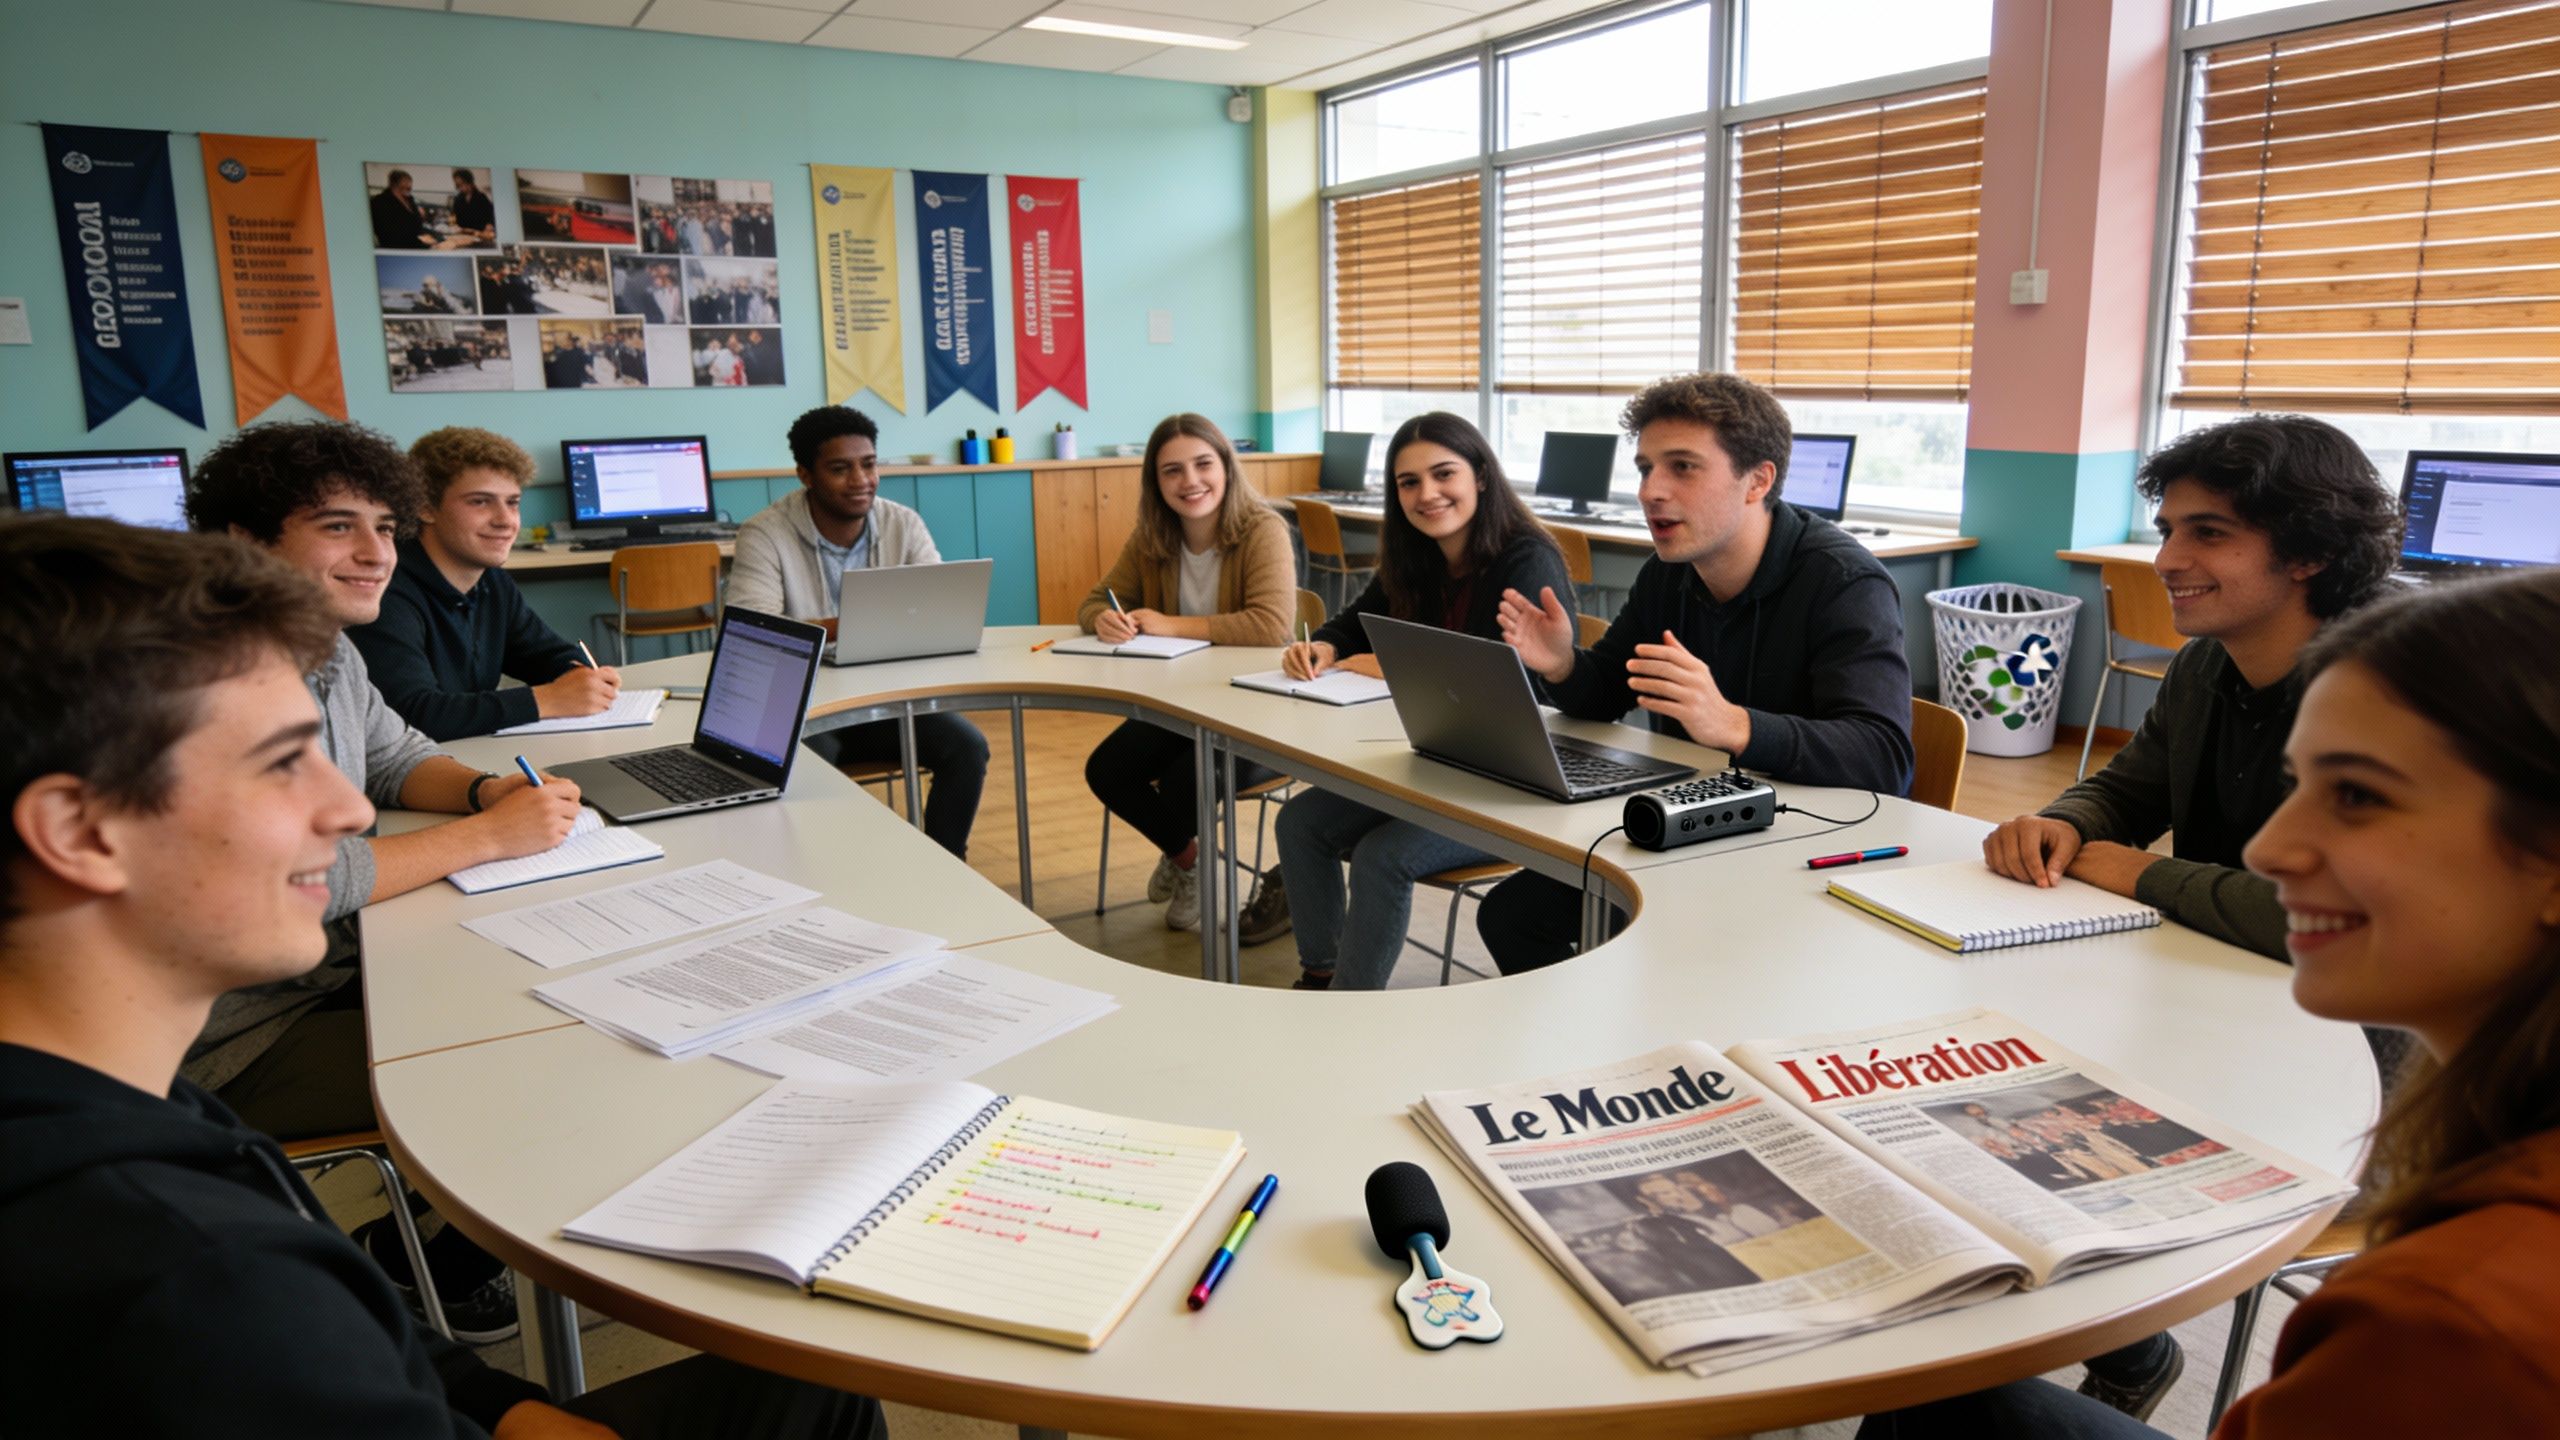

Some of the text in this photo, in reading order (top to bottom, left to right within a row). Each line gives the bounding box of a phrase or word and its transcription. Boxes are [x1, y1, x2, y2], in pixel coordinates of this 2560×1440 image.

[1466, 1065, 1735, 1146] Le Monde
[1780, 1036, 2046, 1103] Libération
